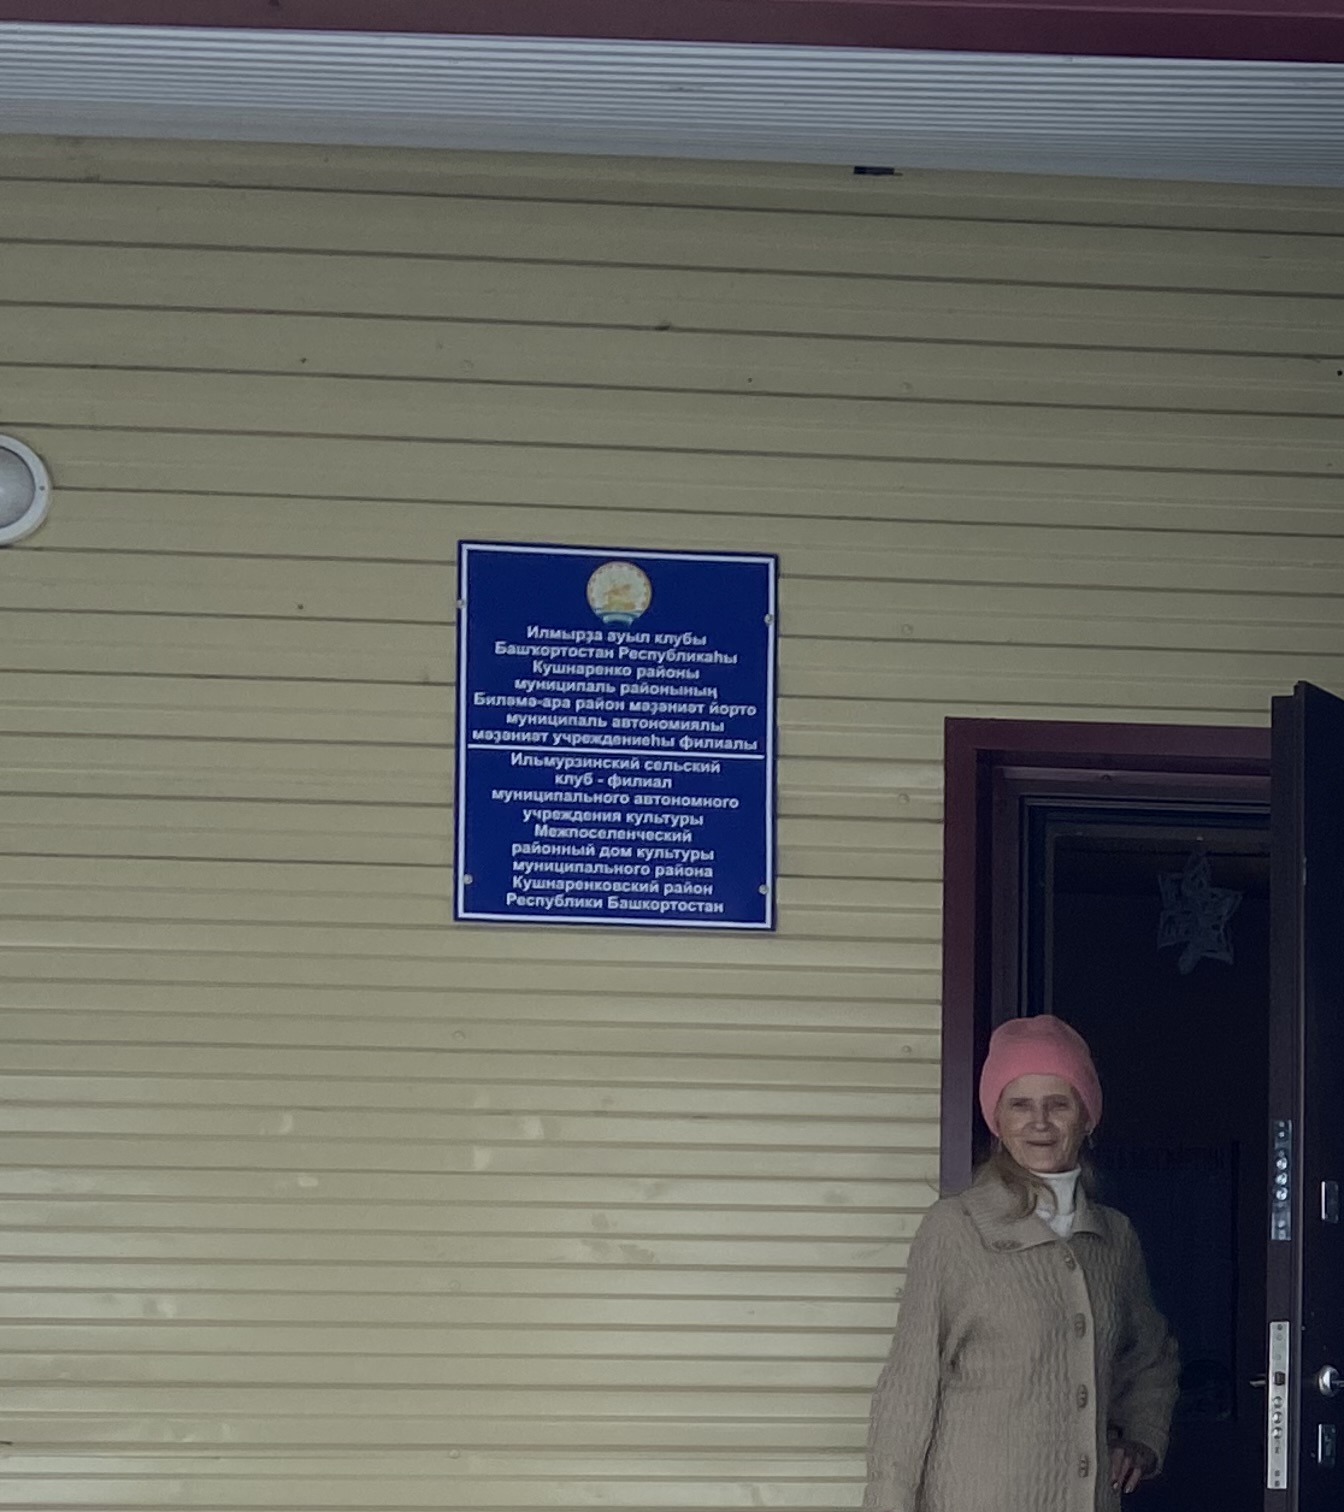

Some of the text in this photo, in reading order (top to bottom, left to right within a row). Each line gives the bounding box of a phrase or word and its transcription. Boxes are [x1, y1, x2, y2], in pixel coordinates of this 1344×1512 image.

[607, 630, 650, 645] ауыл
[654, 631, 707, 648] клубы
[618, 646, 738, 664] Республикаһы
[532, 660, 700, 680] Кушнаренко районы
[514, 678, 616, 693] муниципаль
[575, 696, 625, 712] район
[709, 701, 757, 718] йорто
[506, 713, 725, 732] муниципаль автономиялы
[678, 734, 758, 750] филиалы
[510, 752, 721, 774] Ильмурзинский сельский
[554, 772, 594, 788] клуб
[607, 773, 673, 789] филиал
[491, 789, 739, 809] муниципального автономного
[522, 808, 704, 828] учреждения культуры
[534, 823, 692, 843] Межпоселенческий
[511, 841, 715, 863] районный дом культуры
[512, 860, 714, 879] муниципального района
[512, 875, 714, 896] Кушнаренковский район
[506, 892, 724, 914] Республики Башкортостан
